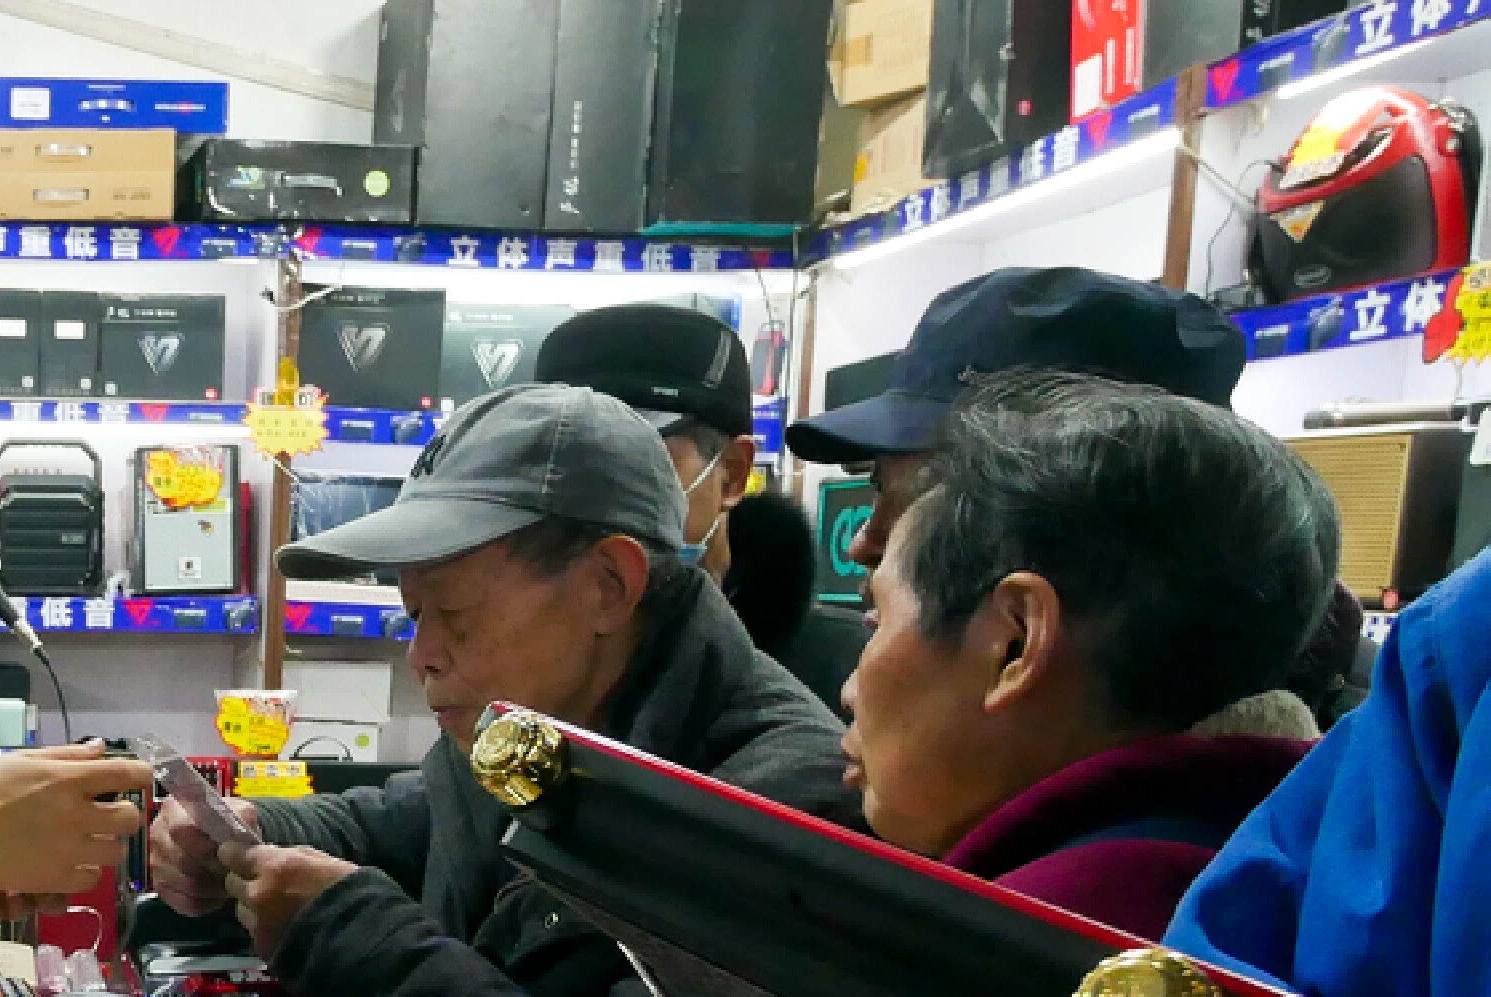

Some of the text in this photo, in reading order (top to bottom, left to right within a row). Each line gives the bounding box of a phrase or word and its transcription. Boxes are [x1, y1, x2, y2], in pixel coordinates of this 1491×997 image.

[1355, 0, 1481, 55] 立体
[447, 236, 720, 272] 立体声重低音
